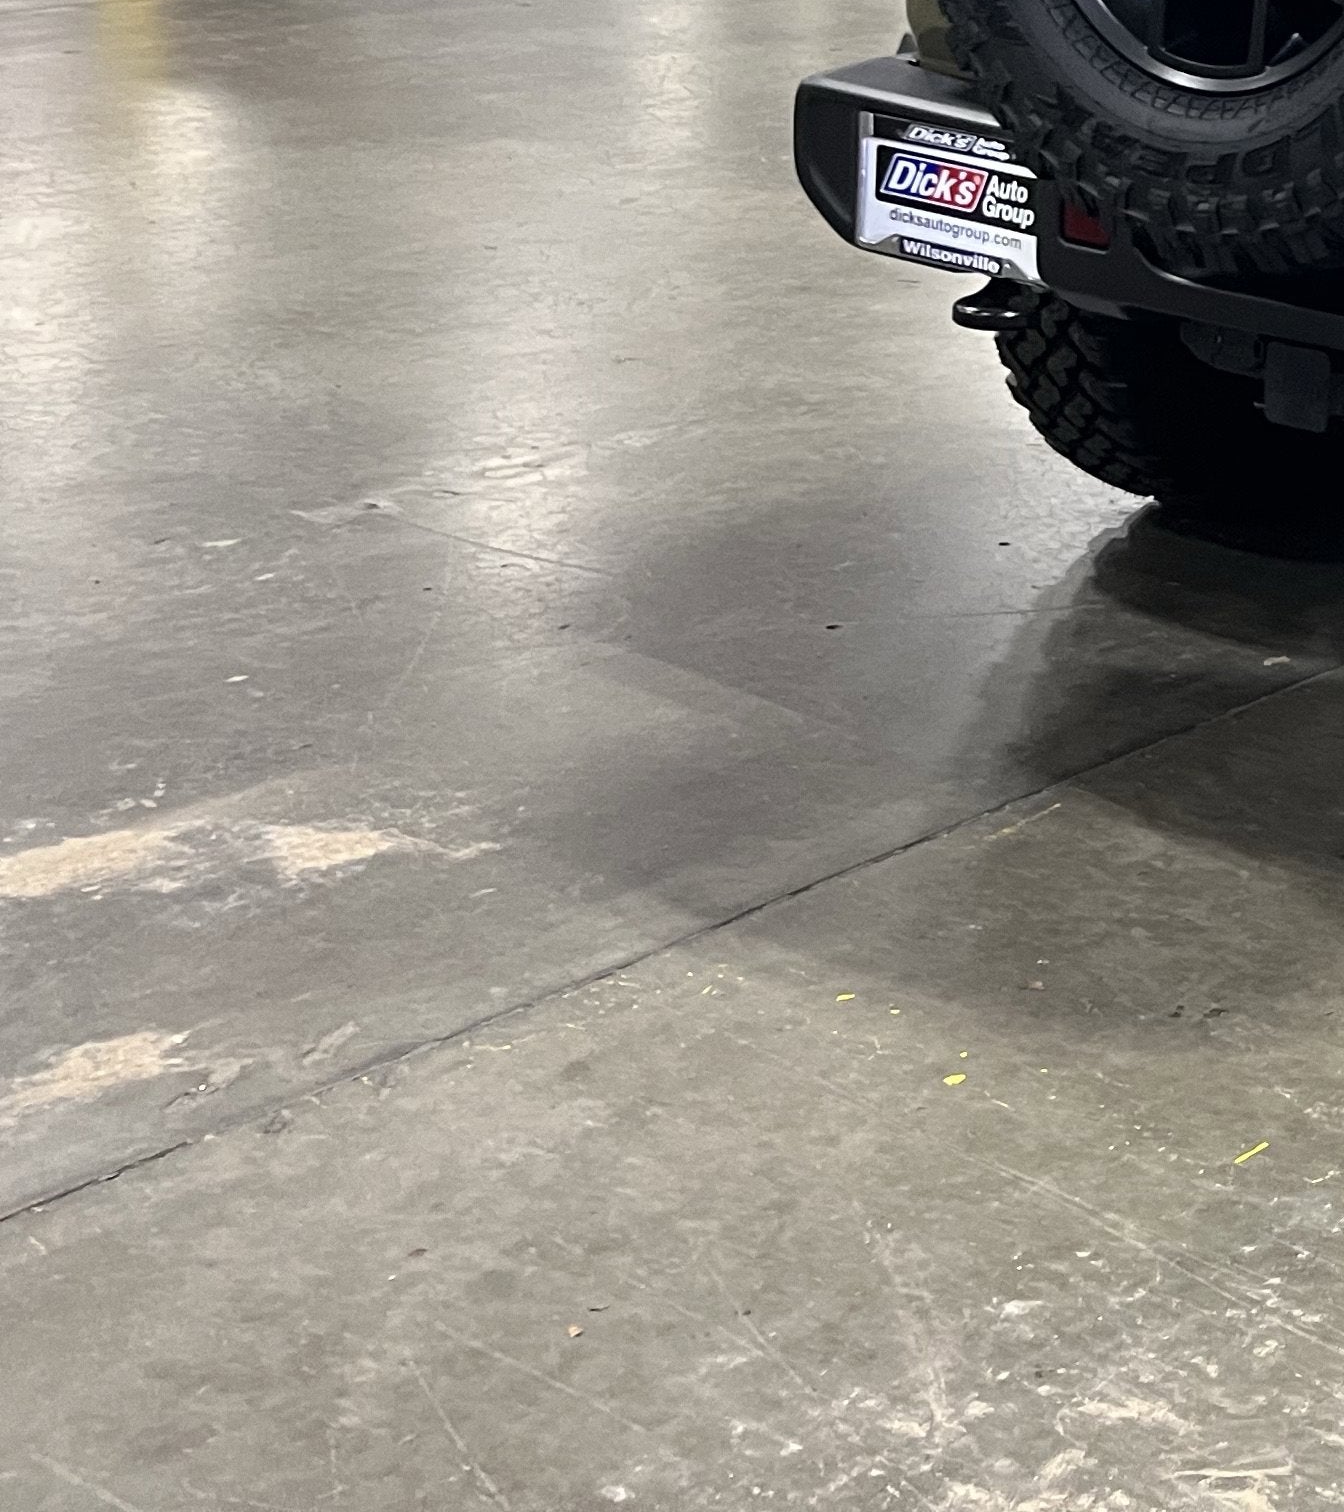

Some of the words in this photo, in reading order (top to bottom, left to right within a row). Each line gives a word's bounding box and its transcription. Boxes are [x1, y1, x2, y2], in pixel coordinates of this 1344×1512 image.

[887, 159, 977, 206] Dick's
[985, 174, 1029, 204] Auto
[888, 207, 1022, 250] dicksautogroup.com
[981, 194, 1036, 230] Group
[902, 239, 1001, 274] Wilsonville
